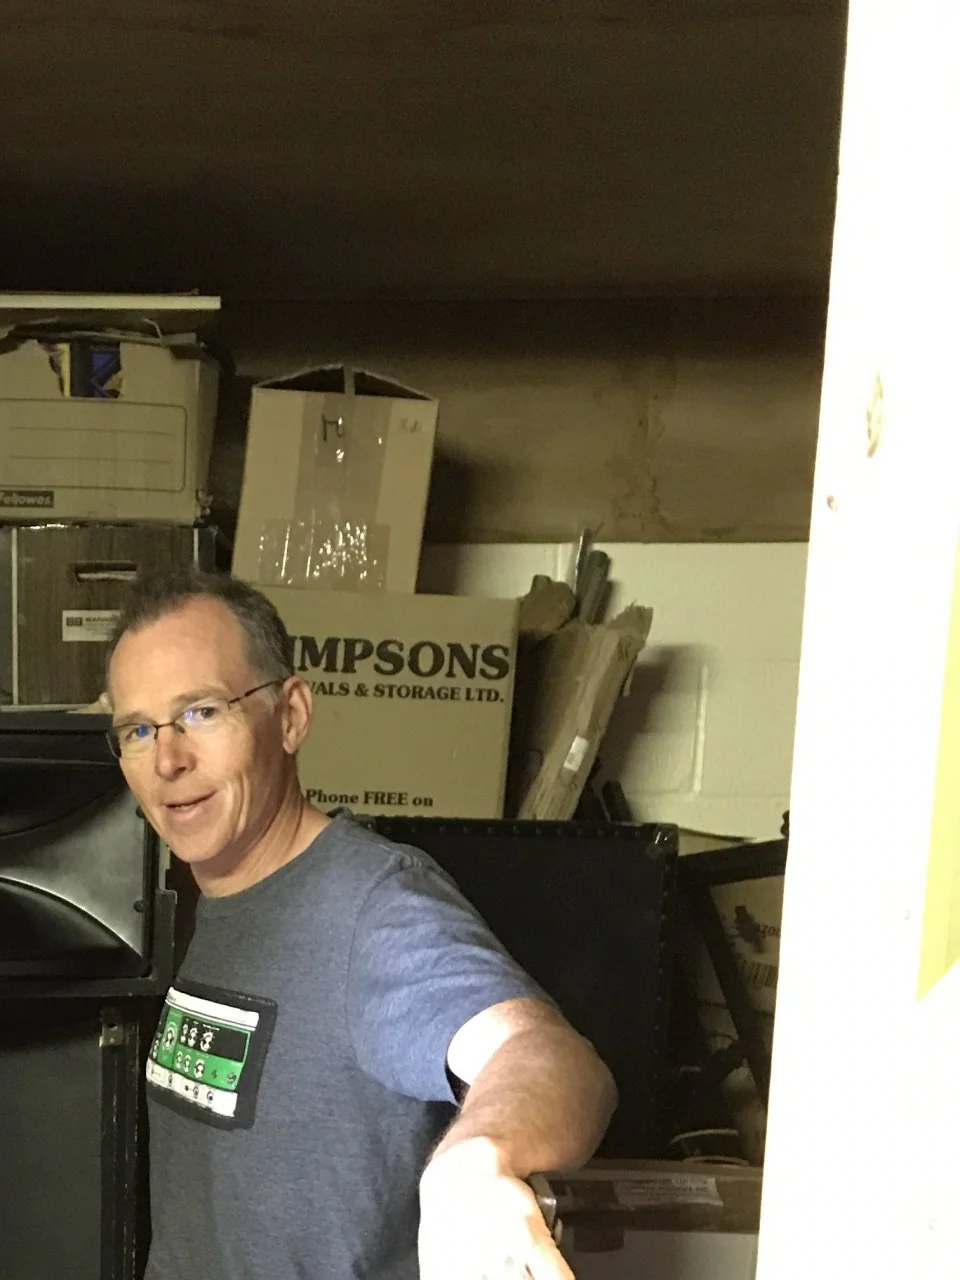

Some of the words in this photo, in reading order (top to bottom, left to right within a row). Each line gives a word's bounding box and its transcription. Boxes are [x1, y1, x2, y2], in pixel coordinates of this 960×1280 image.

[355, 683, 368, 697] &
[374, 684, 461, 701] STORAGE
[465, 687, 504, 703] LTD.
[306, 789, 359, 804] Phone
[363, 791, 408, 806] FREE
[412, 796, 434, 807] on
